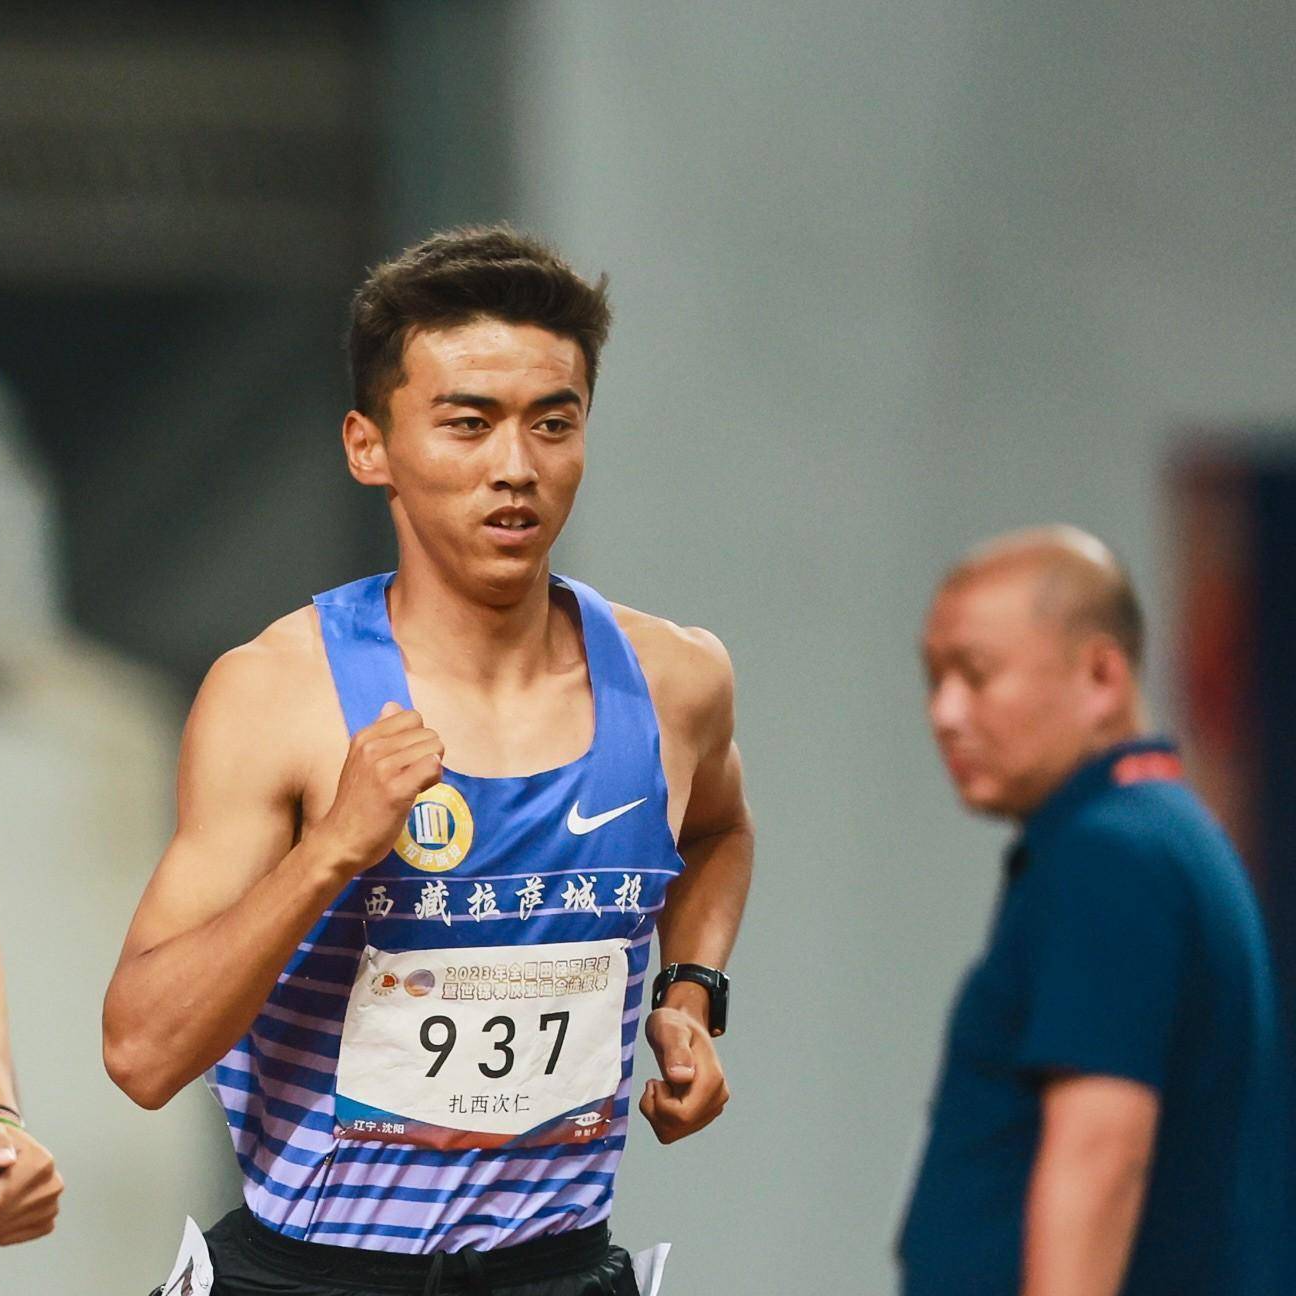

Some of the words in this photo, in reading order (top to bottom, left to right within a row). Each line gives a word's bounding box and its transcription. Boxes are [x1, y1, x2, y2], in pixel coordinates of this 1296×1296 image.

[364, 873, 644, 927] 西藏拉萨城投
[419, 1011, 570, 1079] 937
[448, 1094, 531, 1115] 扎西次仁
